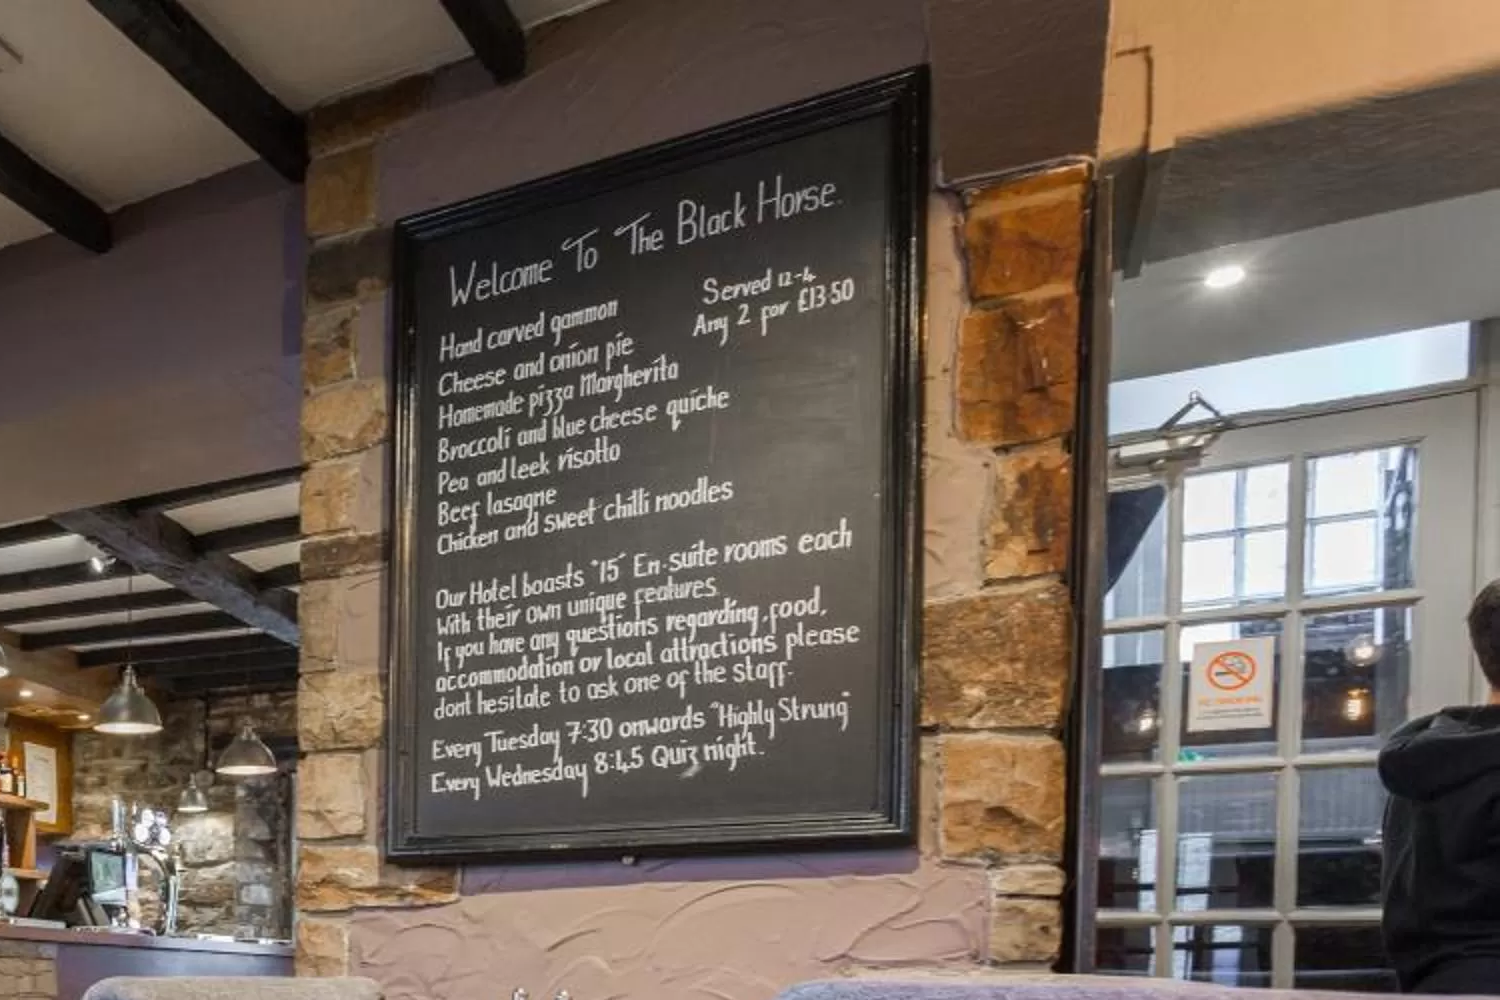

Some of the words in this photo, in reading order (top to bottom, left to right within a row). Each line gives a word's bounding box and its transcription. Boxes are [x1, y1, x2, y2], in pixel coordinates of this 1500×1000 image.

[449, 259, 553, 307] Welcome
[561, 228, 599, 272] To
[613, 212, 665, 255] The
[677, 191, 747, 246] Black
[703, 268, 772, 305] Served
[439, 327, 483, 362] Hand
[487, 311, 545, 349] carved
[551, 300, 619, 347] gammon
[692, 314, 729, 347] Any
[738, 304, 750, 325] 2
[760, 300, 789, 336] for
[438, 367, 506, 397] Cheese
[513, 352, 545, 380] and
[549, 342, 599, 373] onion
[605, 331, 633, 371] pie
[439, 391, 525, 430] Homemade
[528, 384, 574, 416] pizza
[580, 353, 679, 403] Margherita
[437, 427, 512, 463] Broccoli
[517, 417, 547, 447] and
[552, 415, 587, 440] blue
[589, 404, 658, 433] cheese
[665, 385, 731, 432] quiche
[437, 471, 469, 495] Pea
[477, 457, 507, 486] and
[510, 452, 551, 479] leek
[558, 435, 621, 472] risotto
[437, 501, 480, 536] Beef
[486, 486, 557, 522] lasagne
[437, 529, 499, 555] Chicken
[504, 512, 539, 542] and
[544, 497, 598, 534] sweet
[603, 487, 650, 522] chilli
[655, 475, 735, 513] noodles
[435, 588, 467, 609] Our
[469, 573, 517, 605] Hotel
[522, 561, 585, 598] boasts
[724, 535, 788, 563] rooms
[798, 517, 852, 554] each
[477, 603, 521, 631] their
[526, 604, 561, 624] own
[567, 592, 627, 624] unique
[435, 652, 574, 693] accommodation
[579, 656, 602, 673] or
[607, 640, 653, 670] local
[660, 631, 777, 663] attractions
[785, 621, 860, 661] please
[437, 641, 451, 673] If
[455, 641, 485, 669] you
[488, 631, 525, 655] have
[530, 631, 560, 659] any
[566, 613, 658, 657] questions
[477, 684, 551, 715] hesitate
[559, 680, 580, 704] to
[587, 674, 619, 699] ask
[624, 672, 661, 694] one
[666, 670, 690, 699] of
[694, 659, 727, 685] the
[431, 739, 483, 768] Every
[483, 724, 561, 762] Tuesday
[566, 718, 613, 744] 7:30
[618, 704, 706, 738] onwards
[431, 772, 480, 801] Every
[486, 758, 588, 798] Wednesday
[594, 746, 644, 774] 8:45
[651, 740, 701, 770] Quiz
